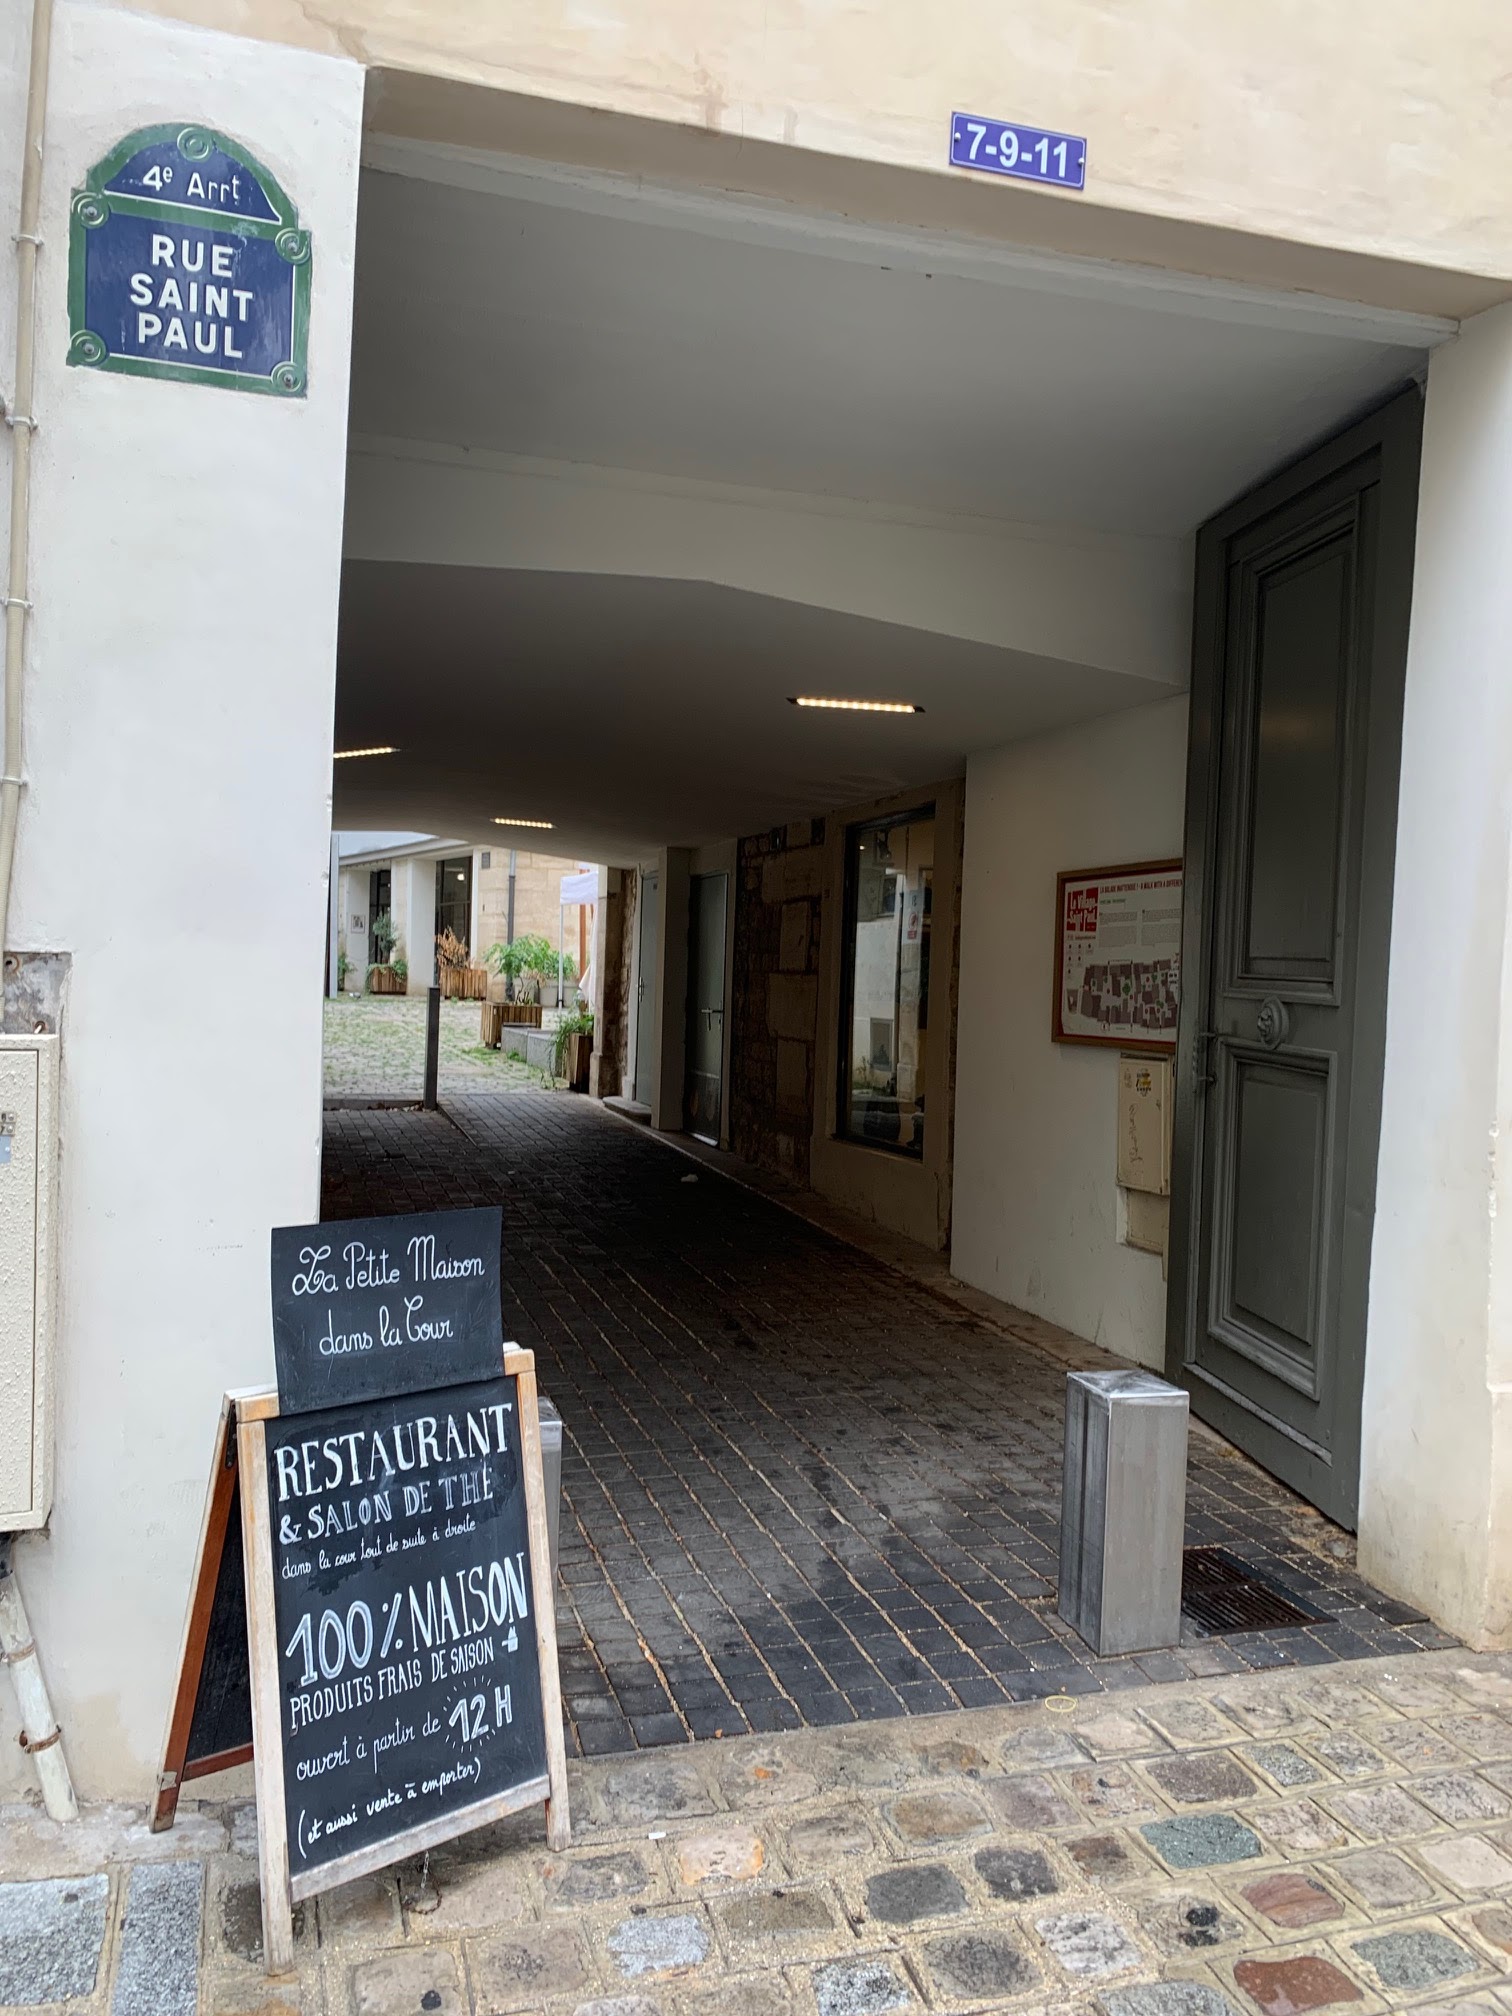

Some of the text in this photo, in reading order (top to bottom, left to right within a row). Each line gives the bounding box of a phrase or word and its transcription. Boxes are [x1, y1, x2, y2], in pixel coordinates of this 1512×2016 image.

[967, 122, 1068, 179] 7-9-11
[186, 172, 240, 204] Arrt
[151, 233, 234, 279] RUE
[130, 272, 254, 322] SAINT
[137, 312, 243, 359] PAUL
[292, 1234, 485, 1295] La Petite Maison
[319, 1295, 454, 1356] dans la Cour
[273, 1402, 513, 1503] RESTAURANT
[278, 1514, 303, 1546] &
[307, 1490, 393, 1541] SALON
[402, 1480, 433, 1518] DE
[281, 1556, 312, 1580] dans
[319, 1549, 332, 1571] la
[334, 1554, 357, 1568] cour
[361, 1537, 383, 1562] tout
[386, 1533, 399, 1554] de
[401, 1528, 427, 1551] suite
[445, 1513, 477, 1539] droite
[407, 1552, 529, 1653] MAISON
[289, 1636, 495, 1730] PRODUITS FRAIS DE SAISON
[296, 1683, 514, 1781] ouvert à partir de 12 H
[325, 1804, 359, 1835] aussi
[366, 1790, 403, 1817] vente
[421, 1756, 482, 1796] emporter)
